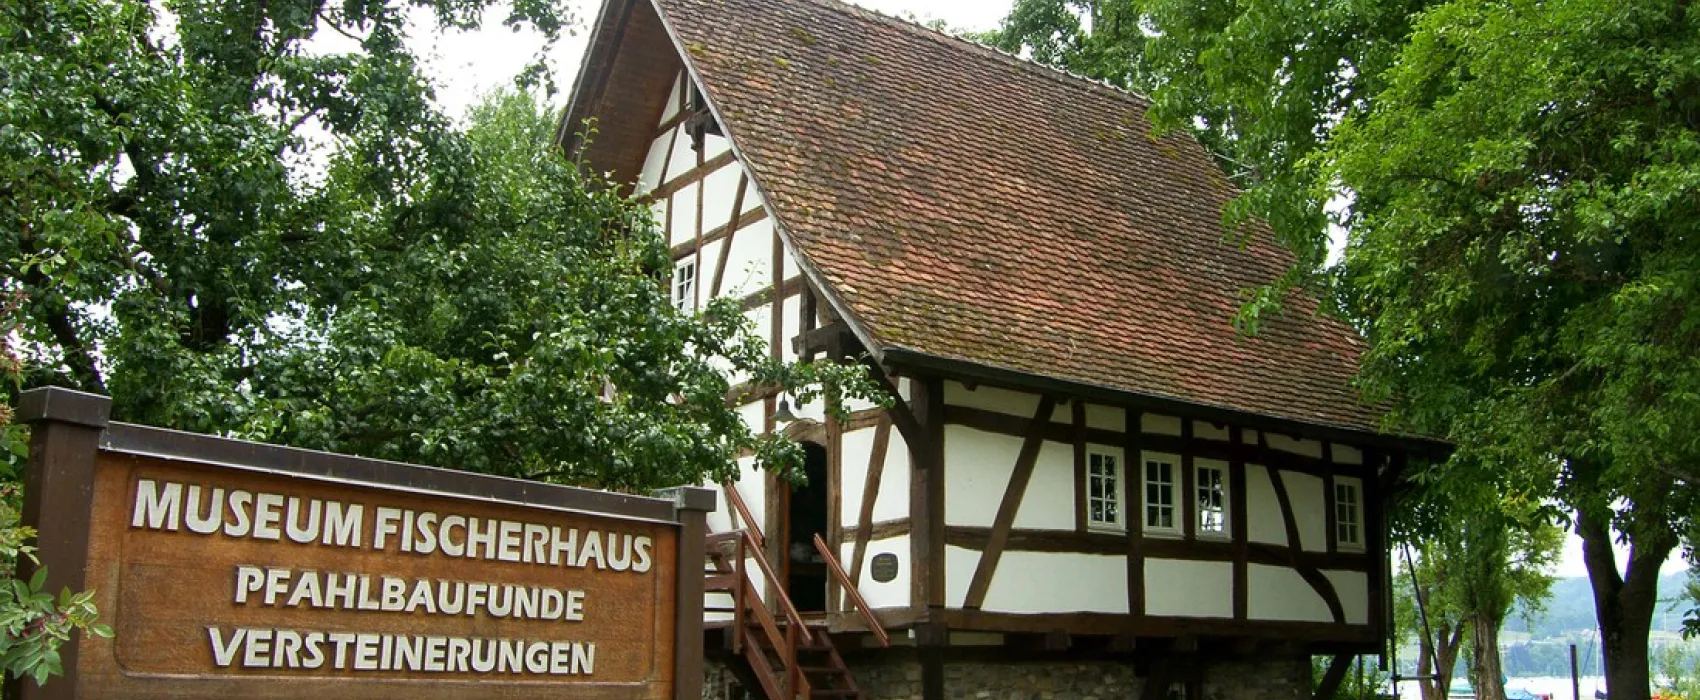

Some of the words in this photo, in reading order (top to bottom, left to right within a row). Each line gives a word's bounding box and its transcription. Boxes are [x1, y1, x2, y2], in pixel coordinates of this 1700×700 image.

[132, 480, 363, 548] MUSEUM
[374, 507, 652, 572] FISCHERHAUS
[235, 566, 585, 621] PFAHLBAUFUNDE
[208, 627, 595, 674] VERSTEINERUNGEN
